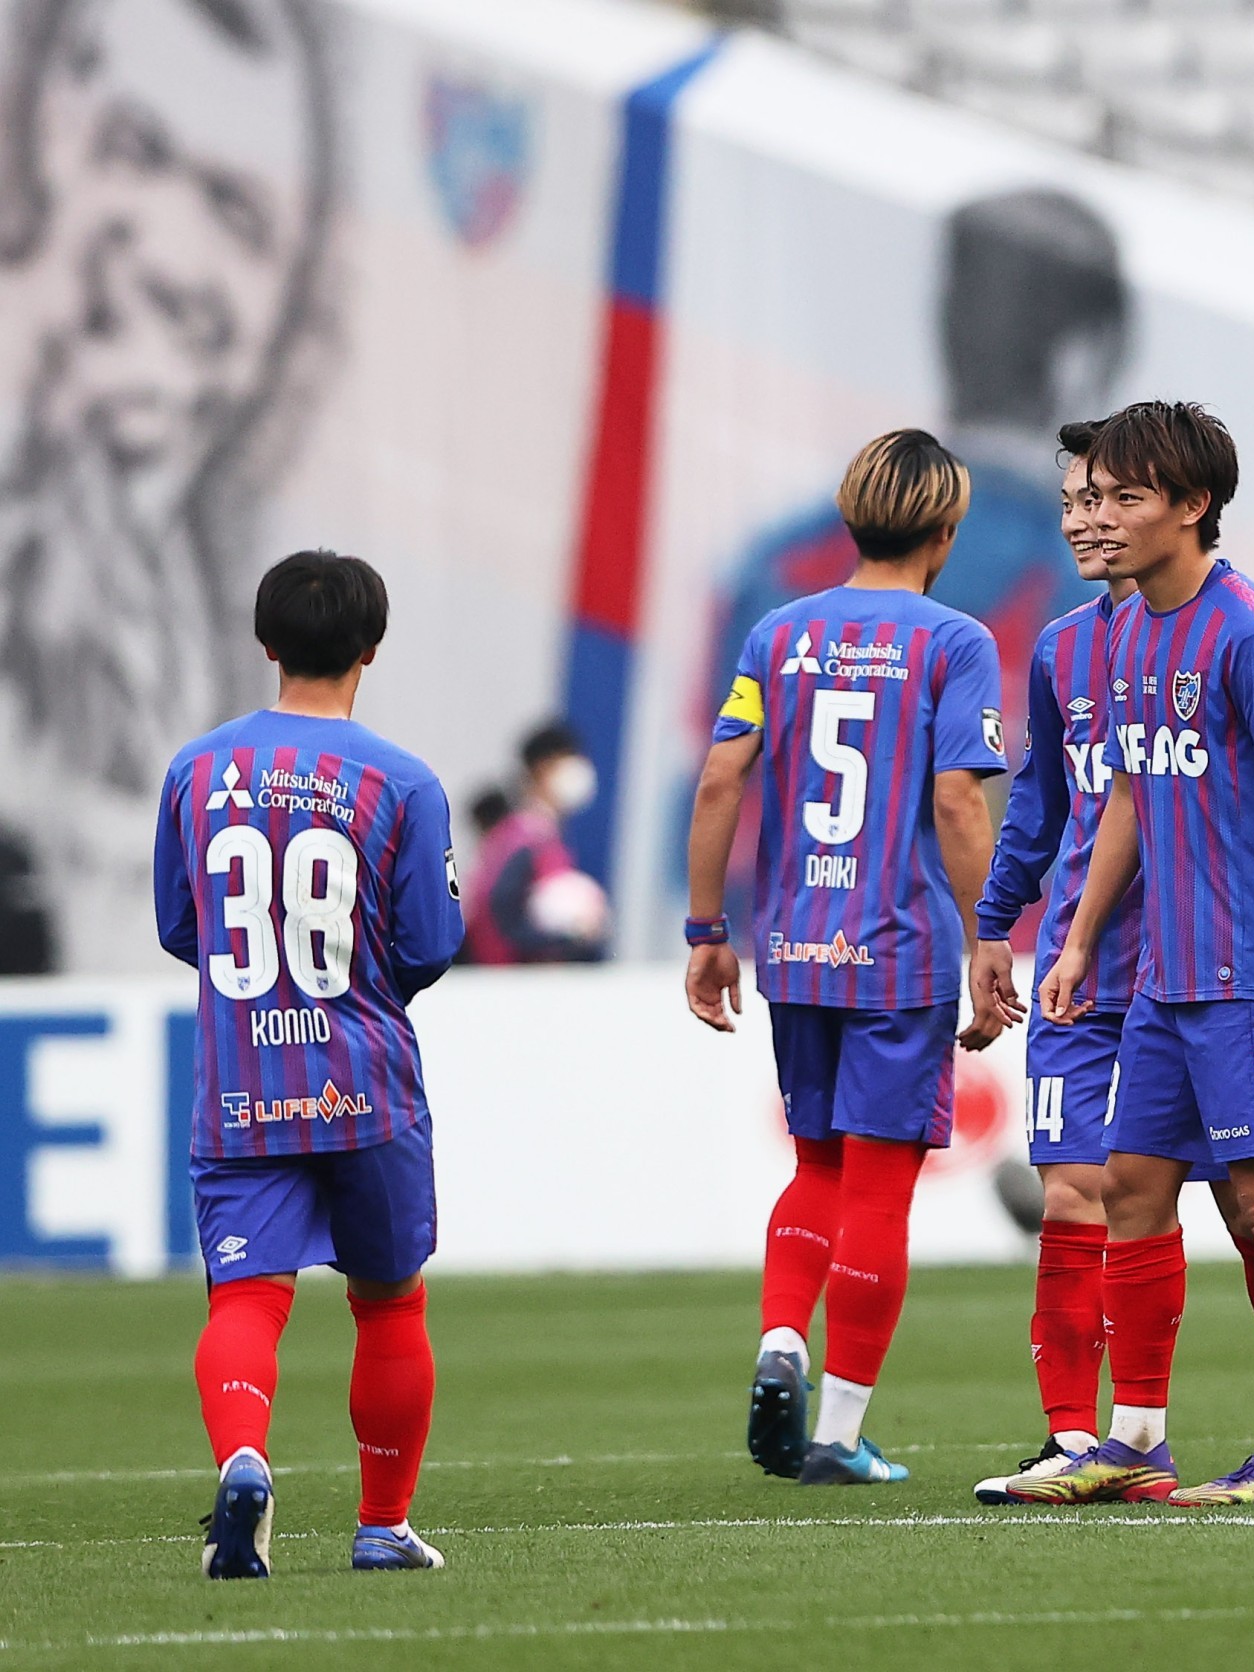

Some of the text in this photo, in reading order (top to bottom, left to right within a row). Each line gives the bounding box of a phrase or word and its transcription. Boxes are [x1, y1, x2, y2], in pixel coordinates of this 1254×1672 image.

[827, 640, 903, 662] Mitsubishi
[824, 660, 909, 681] Corporation
[803, 689, 876, 846] 5
[260, 769, 349, 800] Mitsubishi
[257, 790, 355, 823] Corporation
[806, 854, 858, 889] DAIKI
[206, 824, 358, 1000] 38
[250, 1006, 331, 1047] KONNO
[1231, 1124, 1250, 1138] GAS
[220, 1251, 247, 1264] umbro
